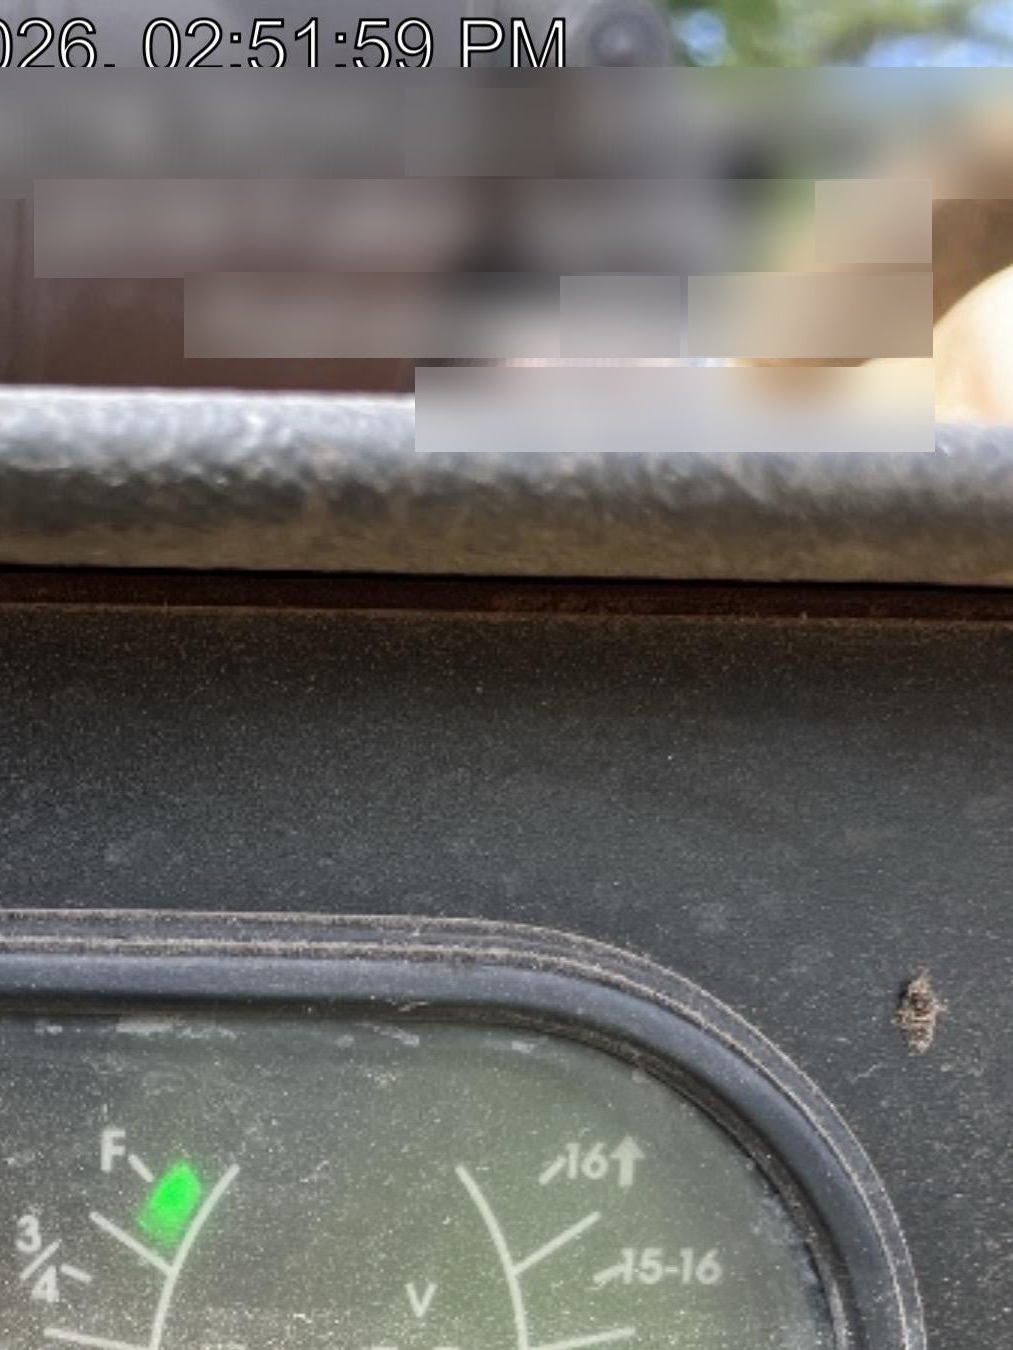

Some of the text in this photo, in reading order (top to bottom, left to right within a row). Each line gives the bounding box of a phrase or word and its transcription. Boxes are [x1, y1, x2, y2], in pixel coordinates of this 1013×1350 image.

[101, 1129, 126, 1171] F
[565, 1143, 608, 1180] 16
[621, 1248, 722, 1285] 15-16
[405, 1283, 437, 1317] V
